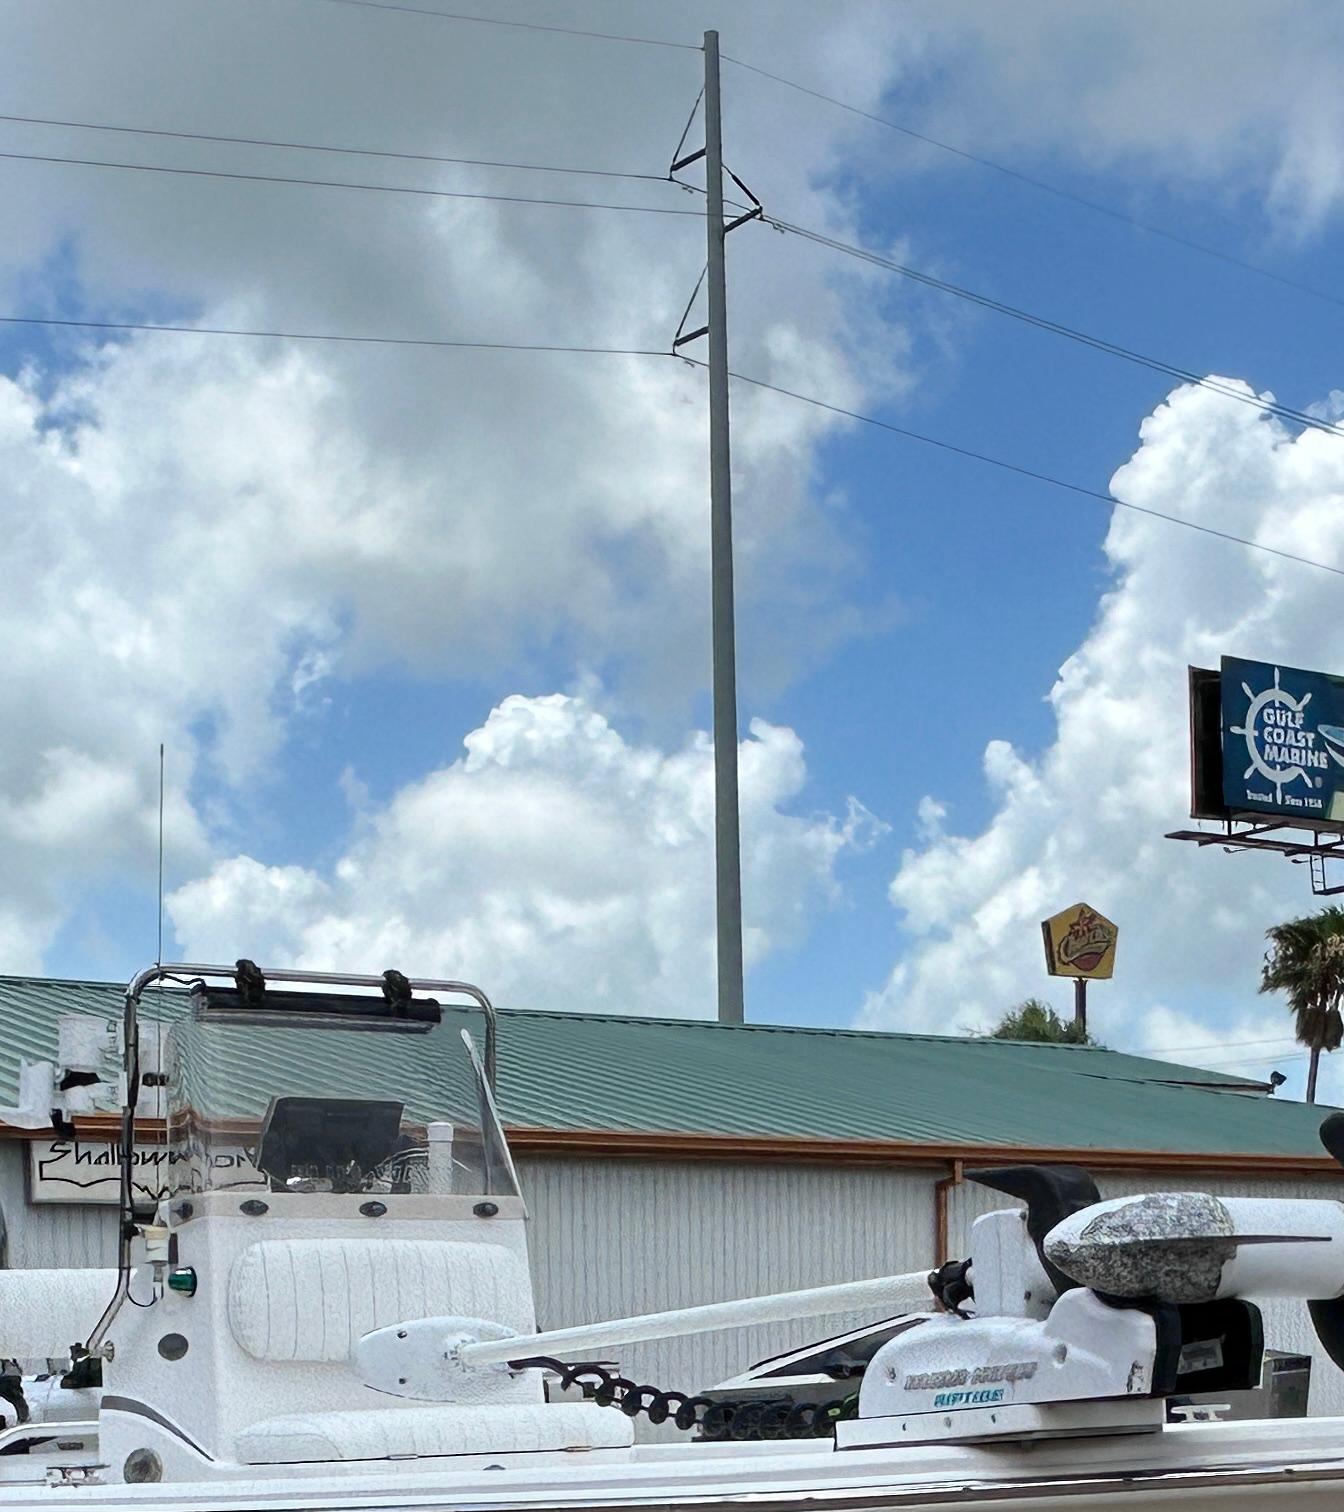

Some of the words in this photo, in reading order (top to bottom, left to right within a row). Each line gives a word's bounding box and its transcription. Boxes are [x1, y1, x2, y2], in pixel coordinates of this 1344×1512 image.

[1263, 708, 1304, 728] GULF
[1264, 726, 1315, 748] COAST
[1264, 743, 1328, 769] MARINE
